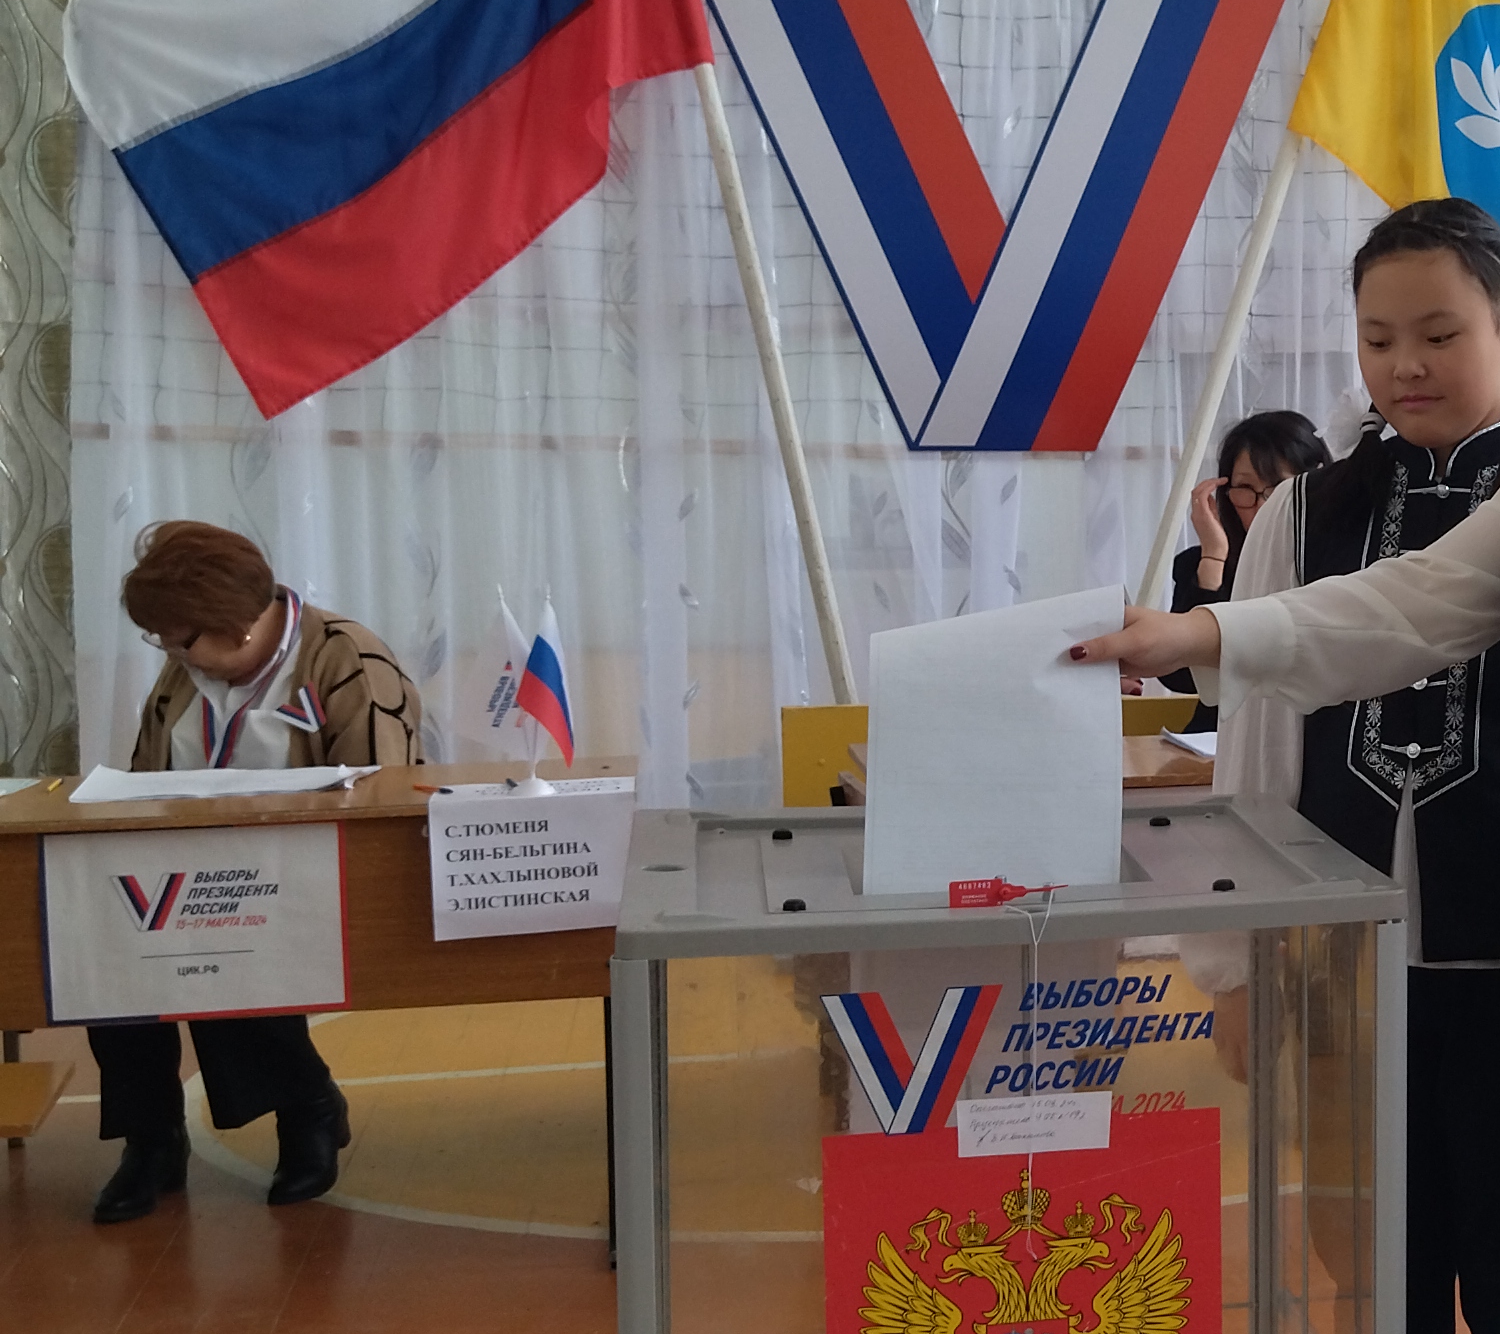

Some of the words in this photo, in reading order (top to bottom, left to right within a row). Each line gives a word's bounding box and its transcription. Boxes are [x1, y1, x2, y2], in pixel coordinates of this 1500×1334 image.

[445, 819, 549, 839] С.ТЮМЕНЯ
[446, 841, 591, 863] СЯН-БЕЛЬГИНА
[194, 869, 260, 884] ВЫБОРЫ
[447, 862, 599, 887] Т.ХАХЛЫНОВОЙ
[187, 884, 279, 900] ПРЕЗИДЕНТА
[448, 888, 591, 911] ЭЛИСТИНСКАЯ
[180, 901, 240, 916] РОССИИ
[205, 917, 241, 929] МАРТА
[242, 915, 267, 926] 2024
[177, 965, 219, 977] ЦИК.РФ
[1018, 974, 1172, 1012] ВЫБОРЫ
[1001, 1011, 1215, 1053] ПРЕЗИДЕНТА
[985, 1057, 1125, 1094] РОССИИ
[1129, 1090, 1186, 1114] 2024
